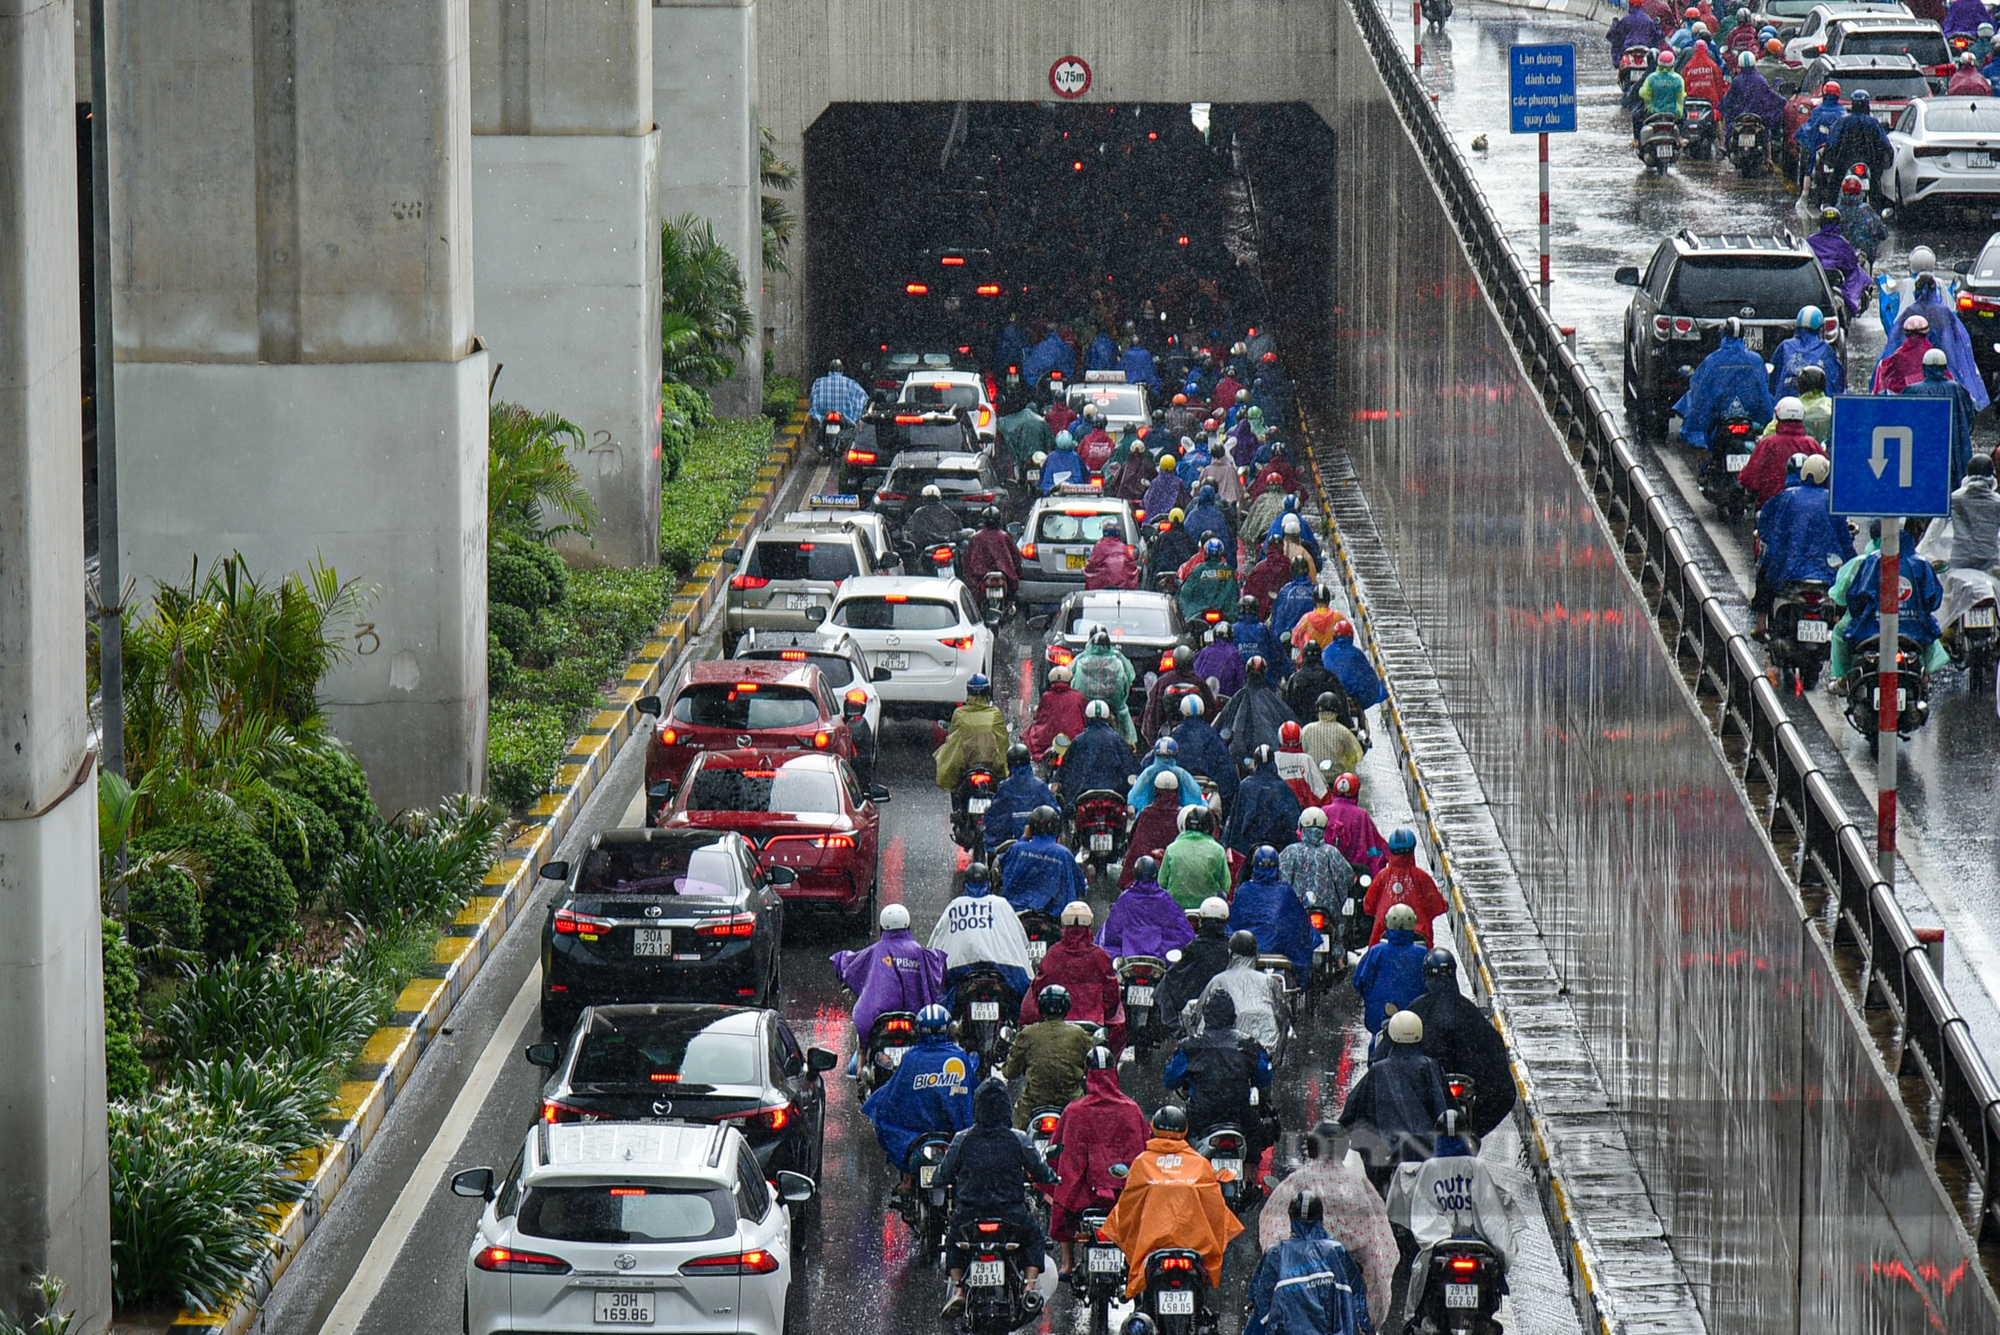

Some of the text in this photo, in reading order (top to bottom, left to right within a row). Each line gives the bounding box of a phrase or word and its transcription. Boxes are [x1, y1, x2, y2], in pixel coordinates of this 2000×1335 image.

[1056, 71, 1085, 84] 4,75m
[1546, 73, 1562, 85] cho
[1513, 95, 1527, 105] các
[1524, 114, 1543, 127] quay
[588, 430, 614, 456] 2
[355, 622, 381, 655] 3
[949, 901, 993, 919] nutri
[950, 914, 994, 934] boost
[643, 930, 662, 943] 30A
[635, 943, 671, 955] 873.13
[913, 1072, 960, 1090] BIOMIL
[1090, 1260, 1119, 1271] 611.26
[972, 1274, 1002, 1285] 983.54
[612, 1294, 638, 1307] 30H
[1447, 1296, 1477, 1306] 662.67
[602, 1308, 648, 1321] 169.86
[1161, 1303, 1191, 1313] 458.05
